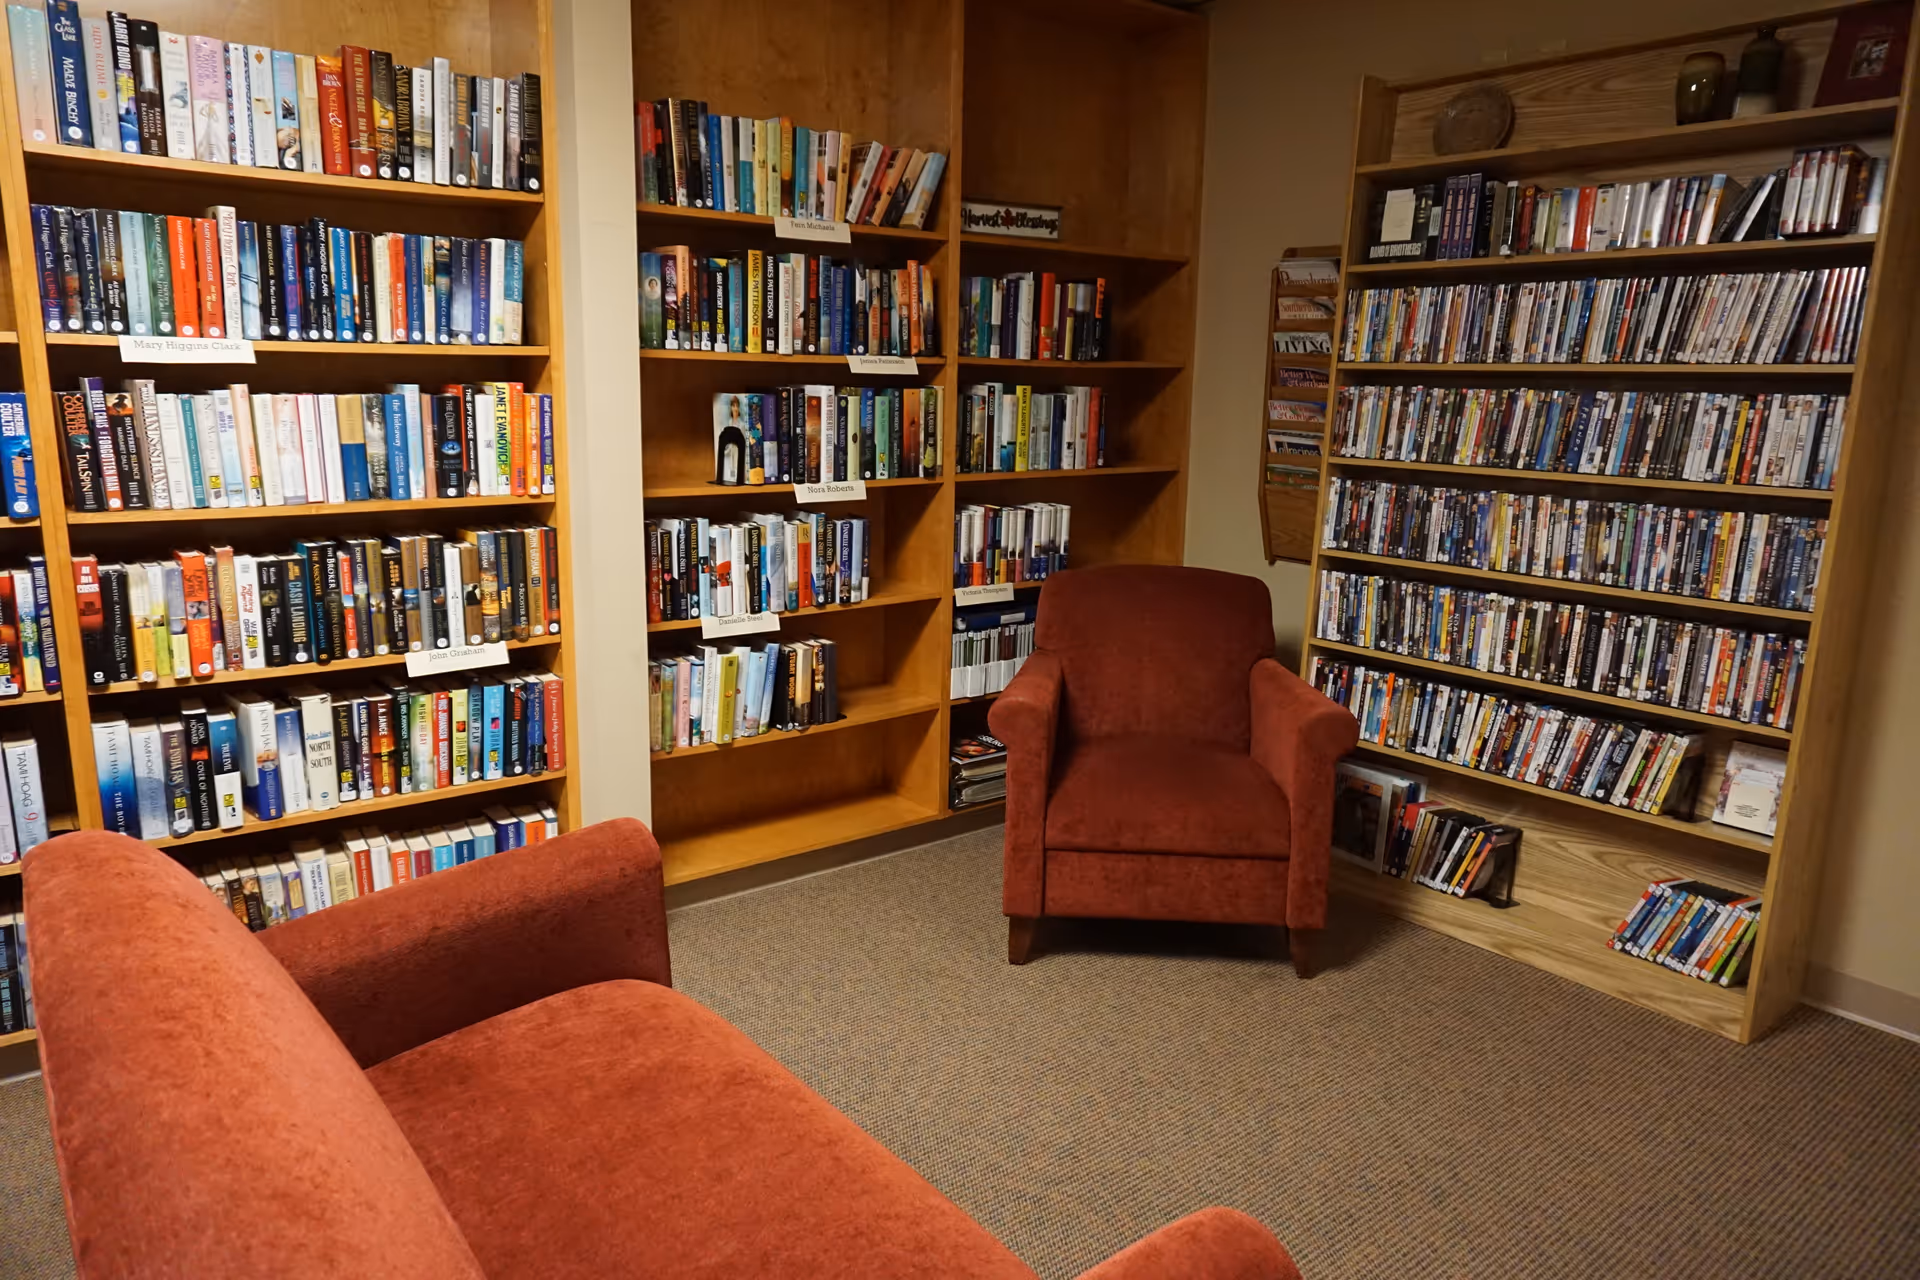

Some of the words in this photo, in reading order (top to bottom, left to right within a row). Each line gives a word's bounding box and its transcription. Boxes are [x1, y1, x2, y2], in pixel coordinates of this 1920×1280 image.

[92, 25, 103, 50] JUDY
[113, 17, 129, 45] LARRY
[95, 53, 107, 85] BLUME
[117, 46, 132, 69] BOND
[62, 57, 76, 89] MAEVE
[355, 64, 364, 76] DA
[355, 77, 364, 96] VINCI
[509, 84, 520, 110] SANDRA
[65, 89, 79, 124] BINCHY
[356, 97, 366, 112] CODE
[397, 99, 410, 132] BROWN
[509, 110, 520, 138] BROWN
[790, 221, 806, 229] Fern
[807, 221, 835, 231] Michaels
[960, 208, 1002, 228] Harvest
[1015, 212, 1059, 235] Blessings
[41, 225, 51, 251] Higgins
[108, 231, 117, 256] HIGGINS
[45, 252, 55, 268] Clark
[1370, 245, 1384, 258] BAND
[1390, 243, 1421, 256] BROTHERS
[64, 254, 72, 272] Clark
[206, 263, 214, 282] CLARK
[752, 253, 760, 278] JAMES
[321, 272, 329, 297] CLARK
[752, 280, 760, 326] PATTERSON
[134, 340, 163, 350] Mary
[166, 341, 209, 351] Higgins
[211, 342, 242, 350] Clark
[1275, 341, 1330, 353] LIVING
[91, 390, 105, 412] ROBERT
[496, 385, 506, 413] JANET
[0, 403, 15, 437] COULTER
[12, 403, 26, 436] CATHERINE
[62, 395, 78, 436] COULTER
[826, 409, 834, 432] ROBERTS
[117, 427, 126, 453] MARGARET
[392, 410, 402, 447] hideaway
[124, 417, 136, 453] SHATTERED
[130, 455, 140, 480] SILENCE
[497, 417, 508, 465] EVANOVICH
[97, 436, 116, 475] FORGOTTEN
[76, 452, 93, 492] TAILSPIN
[104, 475, 119, 491] MAN
[807, 485, 825, 494] Nora
[826, 485, 855, 493] Roberts
[690, 524, 698, 550] DANIELLE
[751, 529, 759, 555] DANIELLE
[480, 540, 489, 568] GRISHAM
[326, 558, 336, 589] BROKER
[1791, 556, 1801, 577] MILK
[240, 584, 248, 612] Agents
[288, 582, 304, 604] CASH
[962, 588, 982, 596] Victoria
[291, 606, 307, 643] LANDING
[1452, 614, 1460, 638] NOAH
[1468, 615, 1476, 649] NON-STOP
[429, 652, 448, 662] John
[450, 647, 485, 657] Grisham
[1567, 631, 1579, 669] PHILOMENA
[788, 652, 797, 675] STUART
[1700, 654, 1709, 675] ROUTE
[788, 676, 796, 699] WOODS
[359, 705, 368, 722] LONG
[438, 699, 448, 710] IRIS
[472, 694, 481, 722] SHADOW
[189, 719, 198, 745] HOWARD
[338, 719, 349, 737] JANCE
[360, 722, 368, 737] TIME
[378, 715, 388, 735] JANCE
[438, 711, 448, 739] JOHANSEN
[472, 724, 480, 743] PLAY
[221, 742, 231, 757] TRUE
[309, 742, 331, 753] NORTH
[361, 737, 369, 755] GONE
[439, 741, 448, 771] QUICKSAND
[15, 751, 28, 777] TAMI
[196, 761, 206, 781] COVER
[223, 758, 232, 771] EVIL
[310, 756, 333, 768] SOUTH
[17, 776, 34, 807] HOAG
[114, 791, 124, 810] THE
[200, 791, 210, 813] NIGHT
[116, 811, 126, 829] BOY
